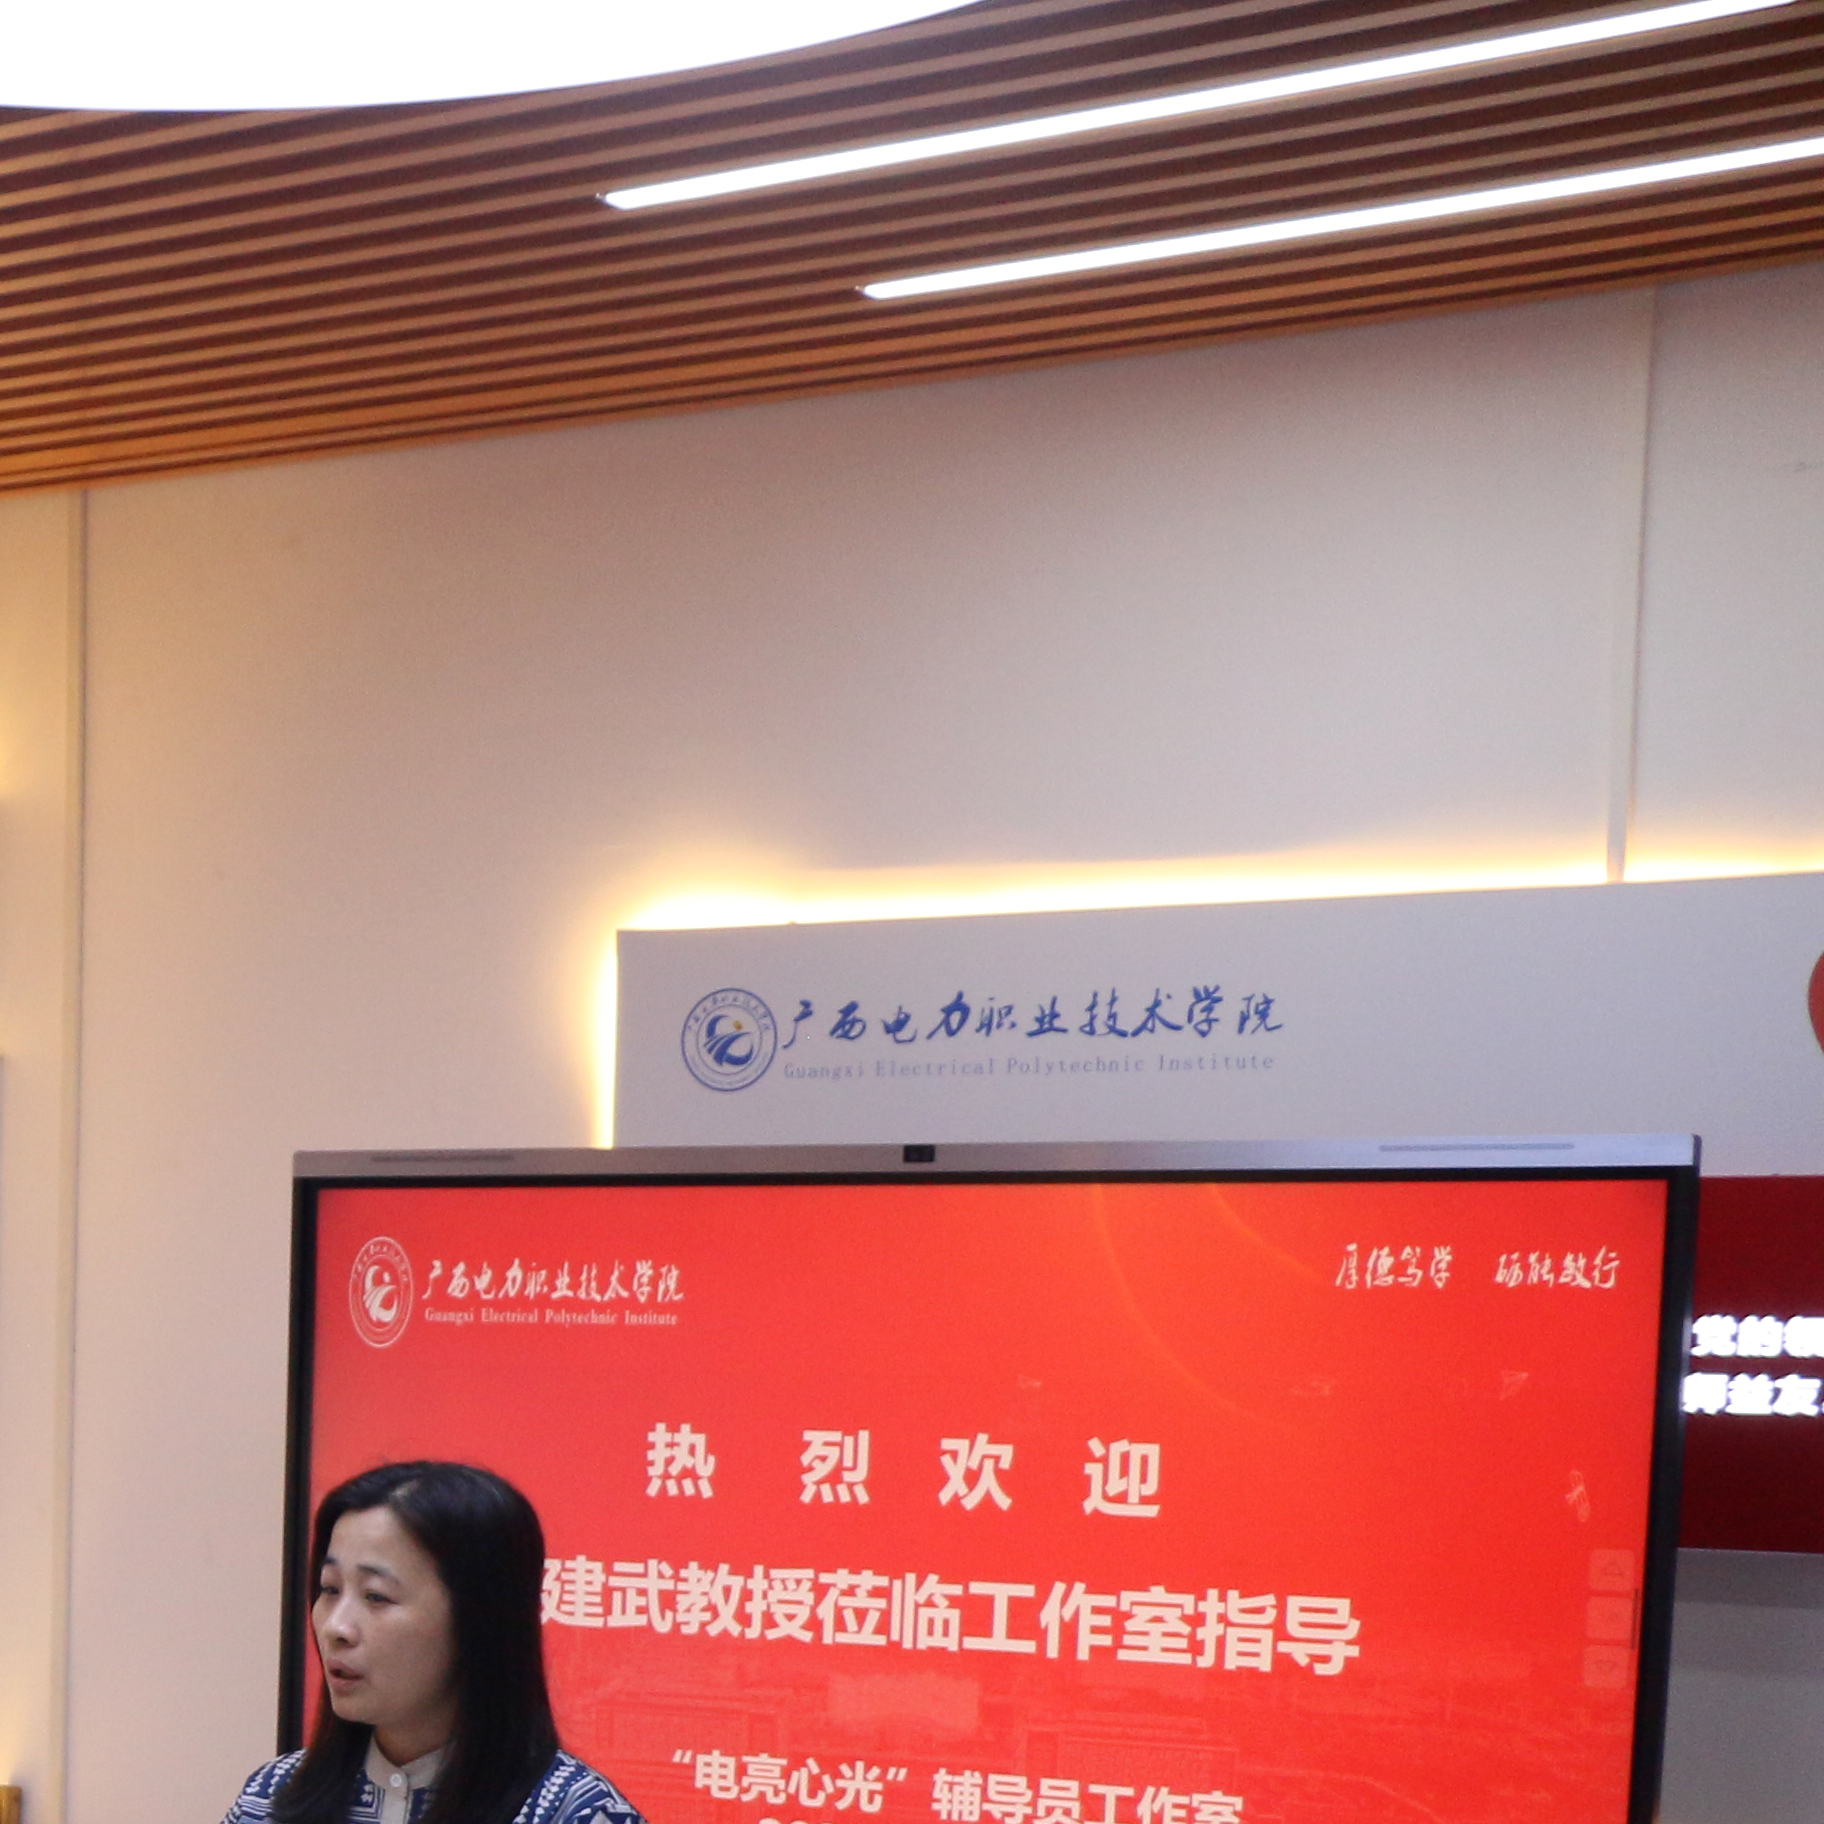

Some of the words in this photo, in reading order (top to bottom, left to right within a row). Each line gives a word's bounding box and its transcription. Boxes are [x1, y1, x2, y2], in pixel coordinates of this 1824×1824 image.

[780, 984, 1284, 1051] 广西电力职业技术学院
[875, 1057, 994, 1078] Electrical
[1006, 1054, 1146, 1077] Polytechnic
[1158, 1052, 1275, 1072] Institute
[421, 1257, 685, 1304] 广西电力职业技术学院
[424, 1307, 474, 1325] Guangxi
[481, 1308, 539, 1325] Electrical
[544, 1309, 618, 1327] Polytechnic
[624, 1310, 678, 1326] Institute
[540, 1554, 1362, 1676] 建武教授莅临工作室指导
